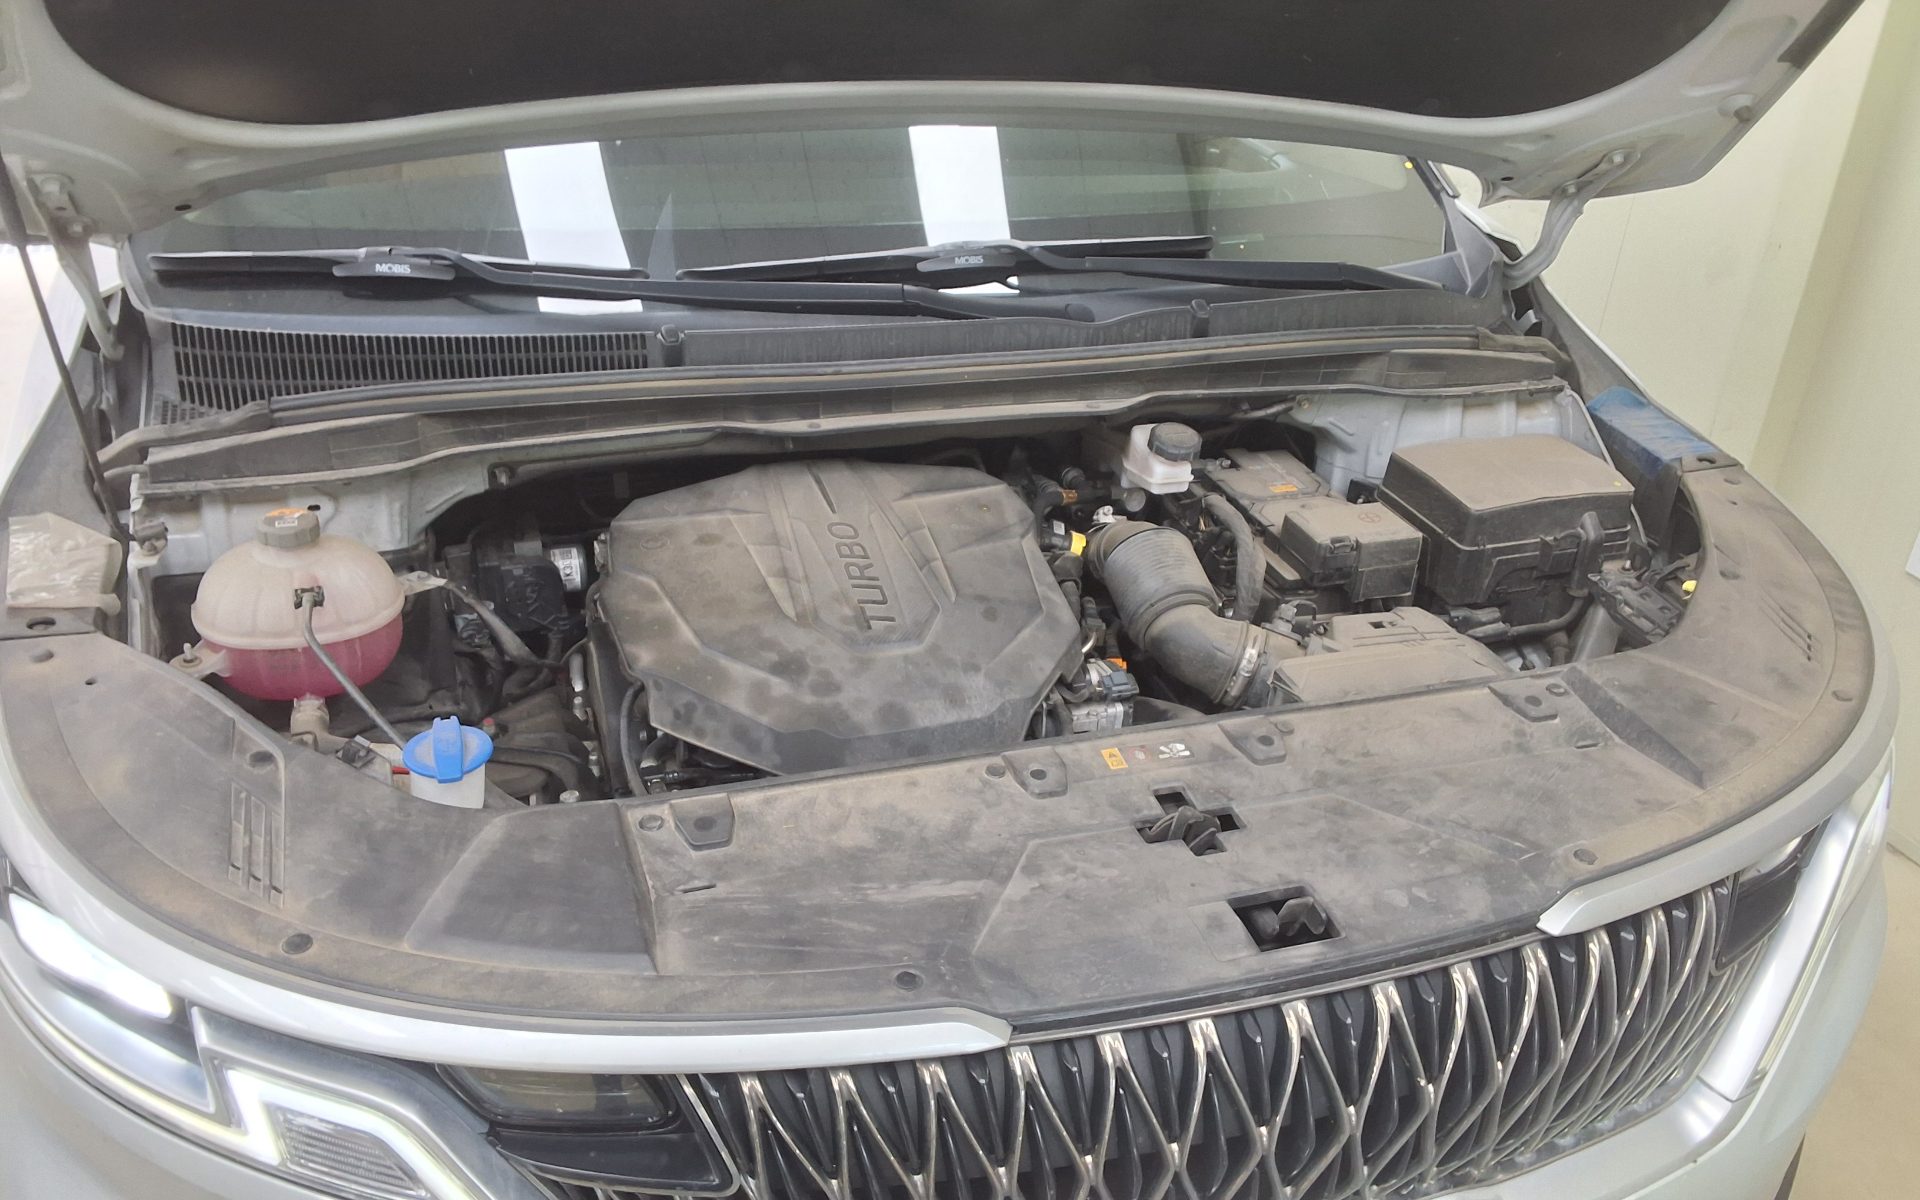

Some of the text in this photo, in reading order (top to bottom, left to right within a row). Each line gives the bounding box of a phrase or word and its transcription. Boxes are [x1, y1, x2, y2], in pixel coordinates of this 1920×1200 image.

[954, 255, 984, 265] MOBIS
[375, 263, 411, 274] MOBIS
[827, 522, 896, 630] TURBO
